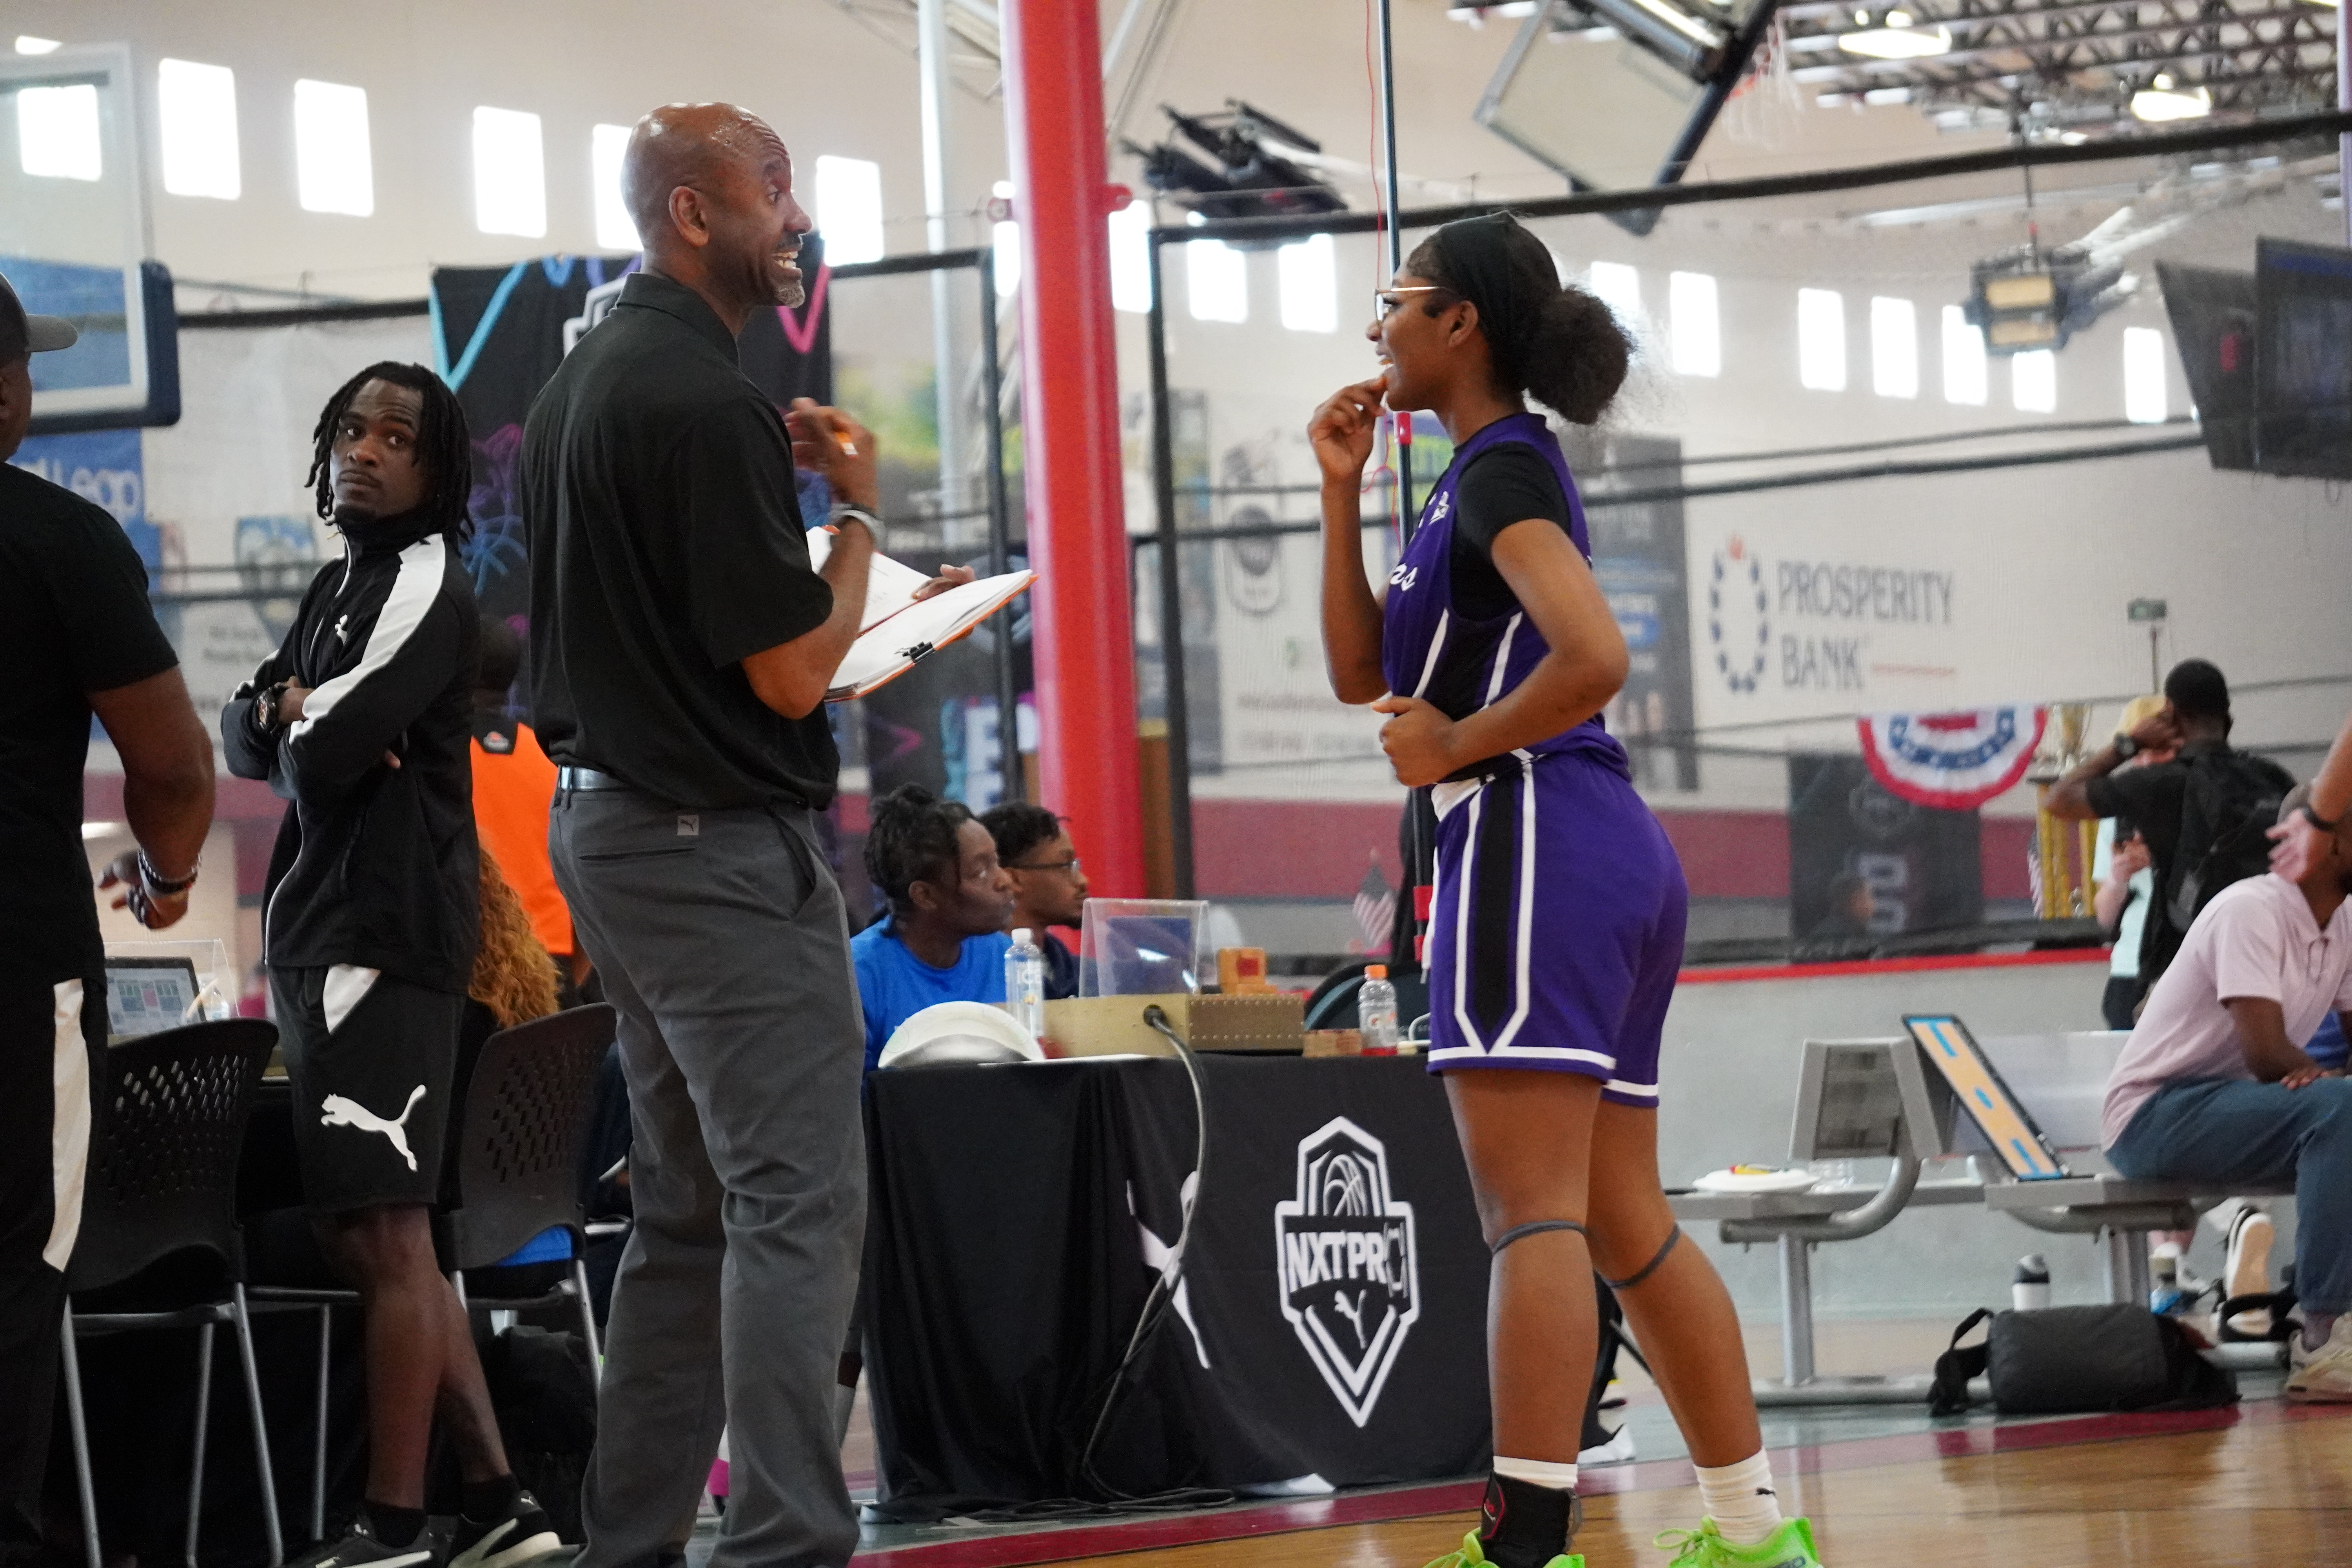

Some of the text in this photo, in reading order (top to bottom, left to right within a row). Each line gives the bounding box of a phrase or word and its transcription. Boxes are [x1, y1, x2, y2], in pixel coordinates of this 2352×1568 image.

[1777, 559, 1955, 625] PROSPERITY
[1782, 633, 1864, 688] BANK
[1286, 1221, 1408, 1299] NXTPRO
